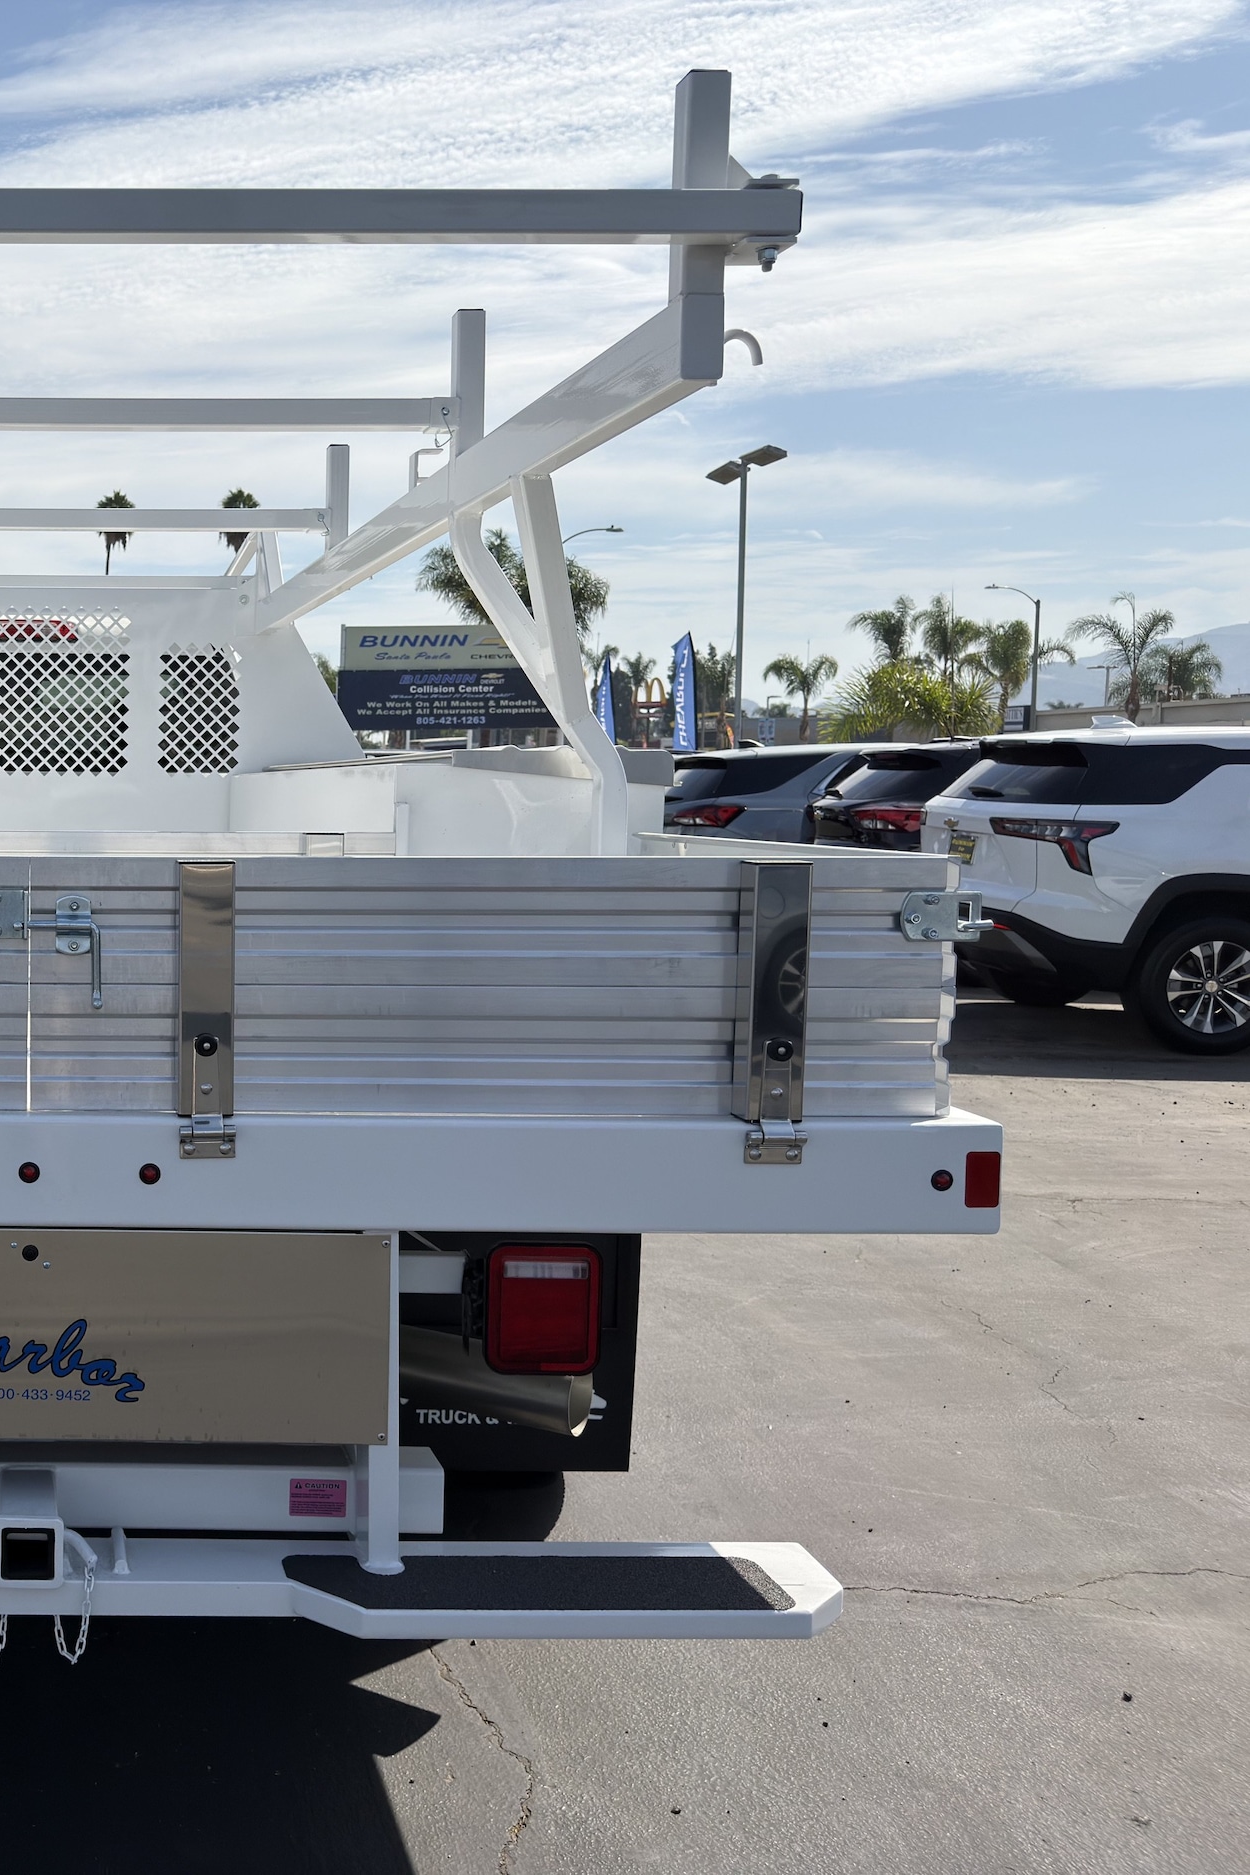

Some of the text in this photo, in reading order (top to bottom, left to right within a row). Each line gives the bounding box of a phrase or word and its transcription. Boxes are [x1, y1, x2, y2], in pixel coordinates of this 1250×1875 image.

[359, 634, 469, 648] BUNNIN
[374, 651, 452, 661] Santa Paula
[399, 674, 477, 684] BUNNIN
[410, 684, 494, 693] Collision Center
[489, 706, 547, 715] Companies
[416, 716, 486, 725] 805-421-1263
[416, 1409, 481, 1425] TRUCK
[304, 1482, 341, 1490] CAUTION
